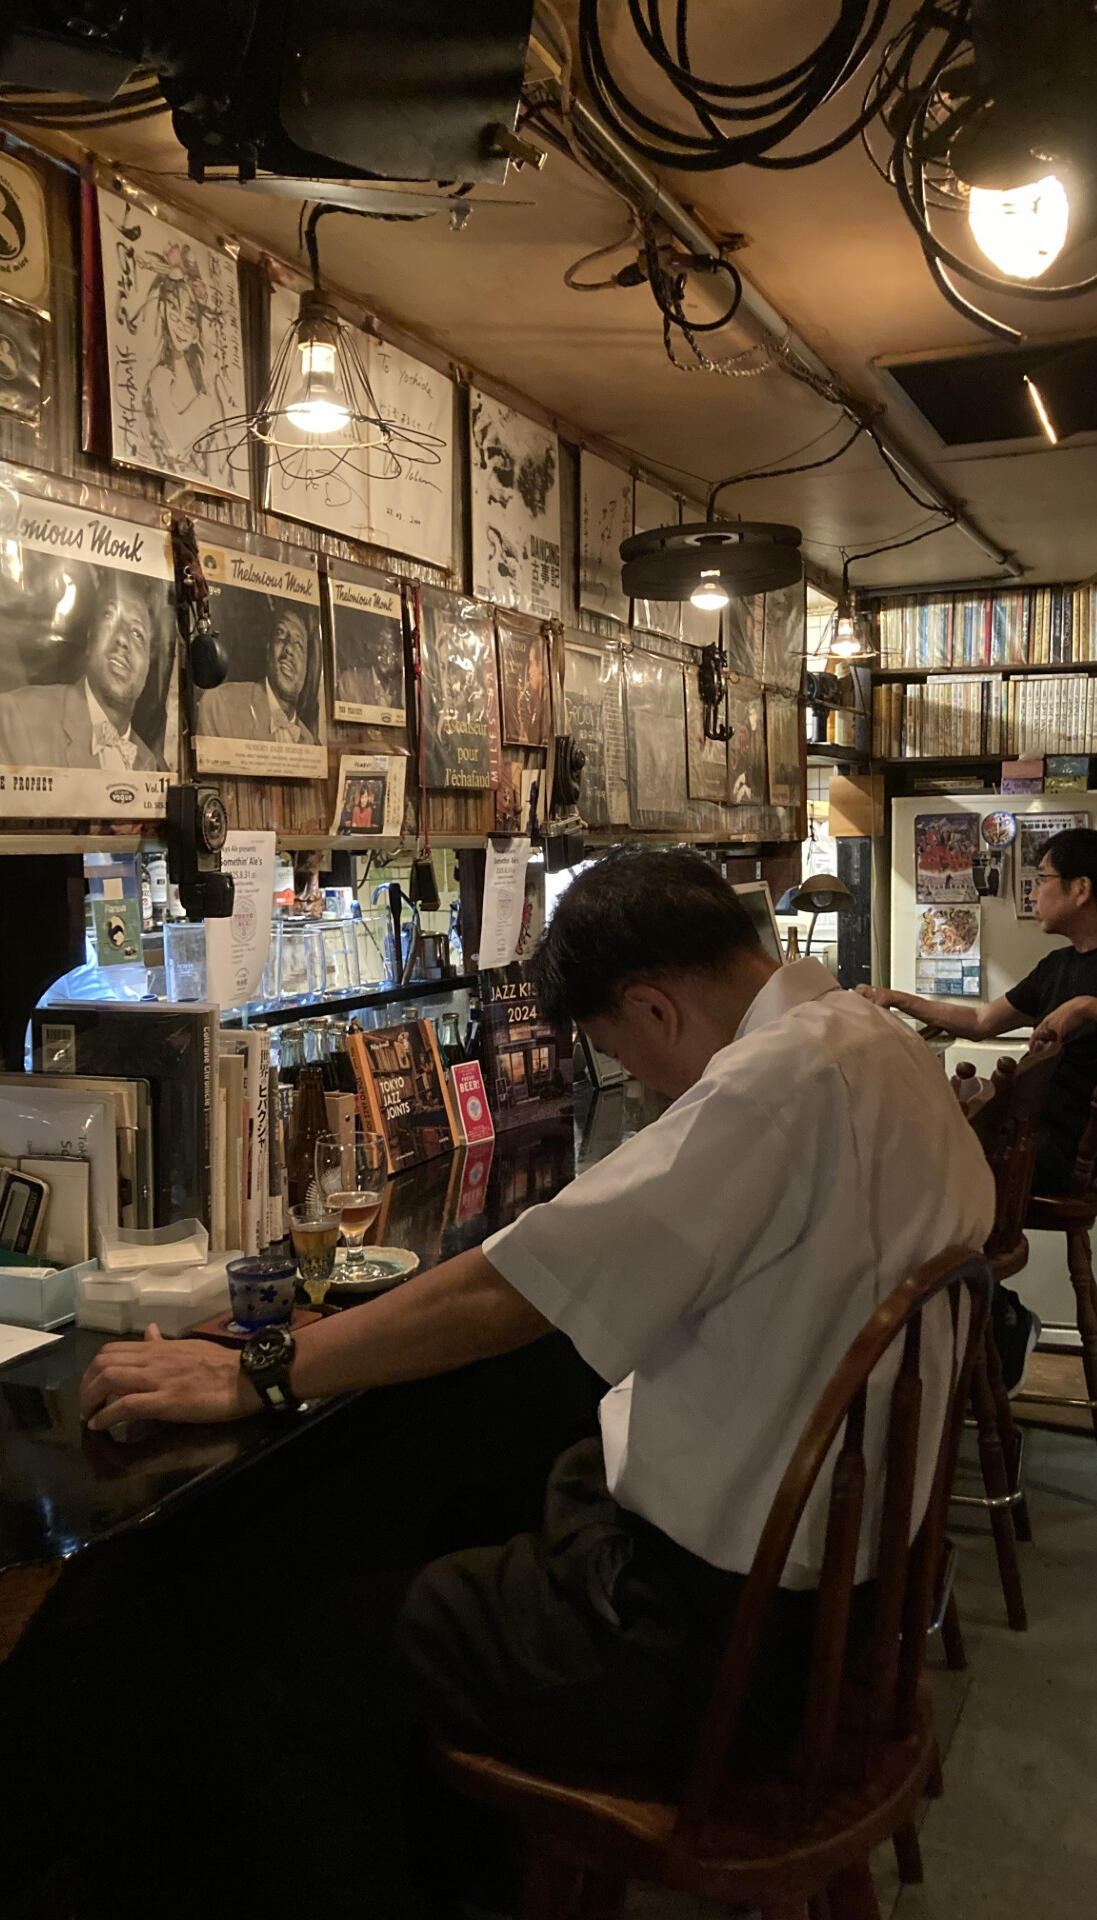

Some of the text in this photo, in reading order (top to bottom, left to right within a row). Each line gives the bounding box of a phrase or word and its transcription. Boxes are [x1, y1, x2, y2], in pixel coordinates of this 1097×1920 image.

[88, 519, 144, 562] Monk
[457, 747, 480, 764] pour
[13, 776, 53, 792] PROPHET
[490, 983, 517, 1001] JAZZ
[507, 1005, 537, 1023] 2024
[380, 1076, 405, 1095] TOKYO
[383, 1091, 402, 1108] JAZZ
[386, 1101, 411, 1121] JOINTS
